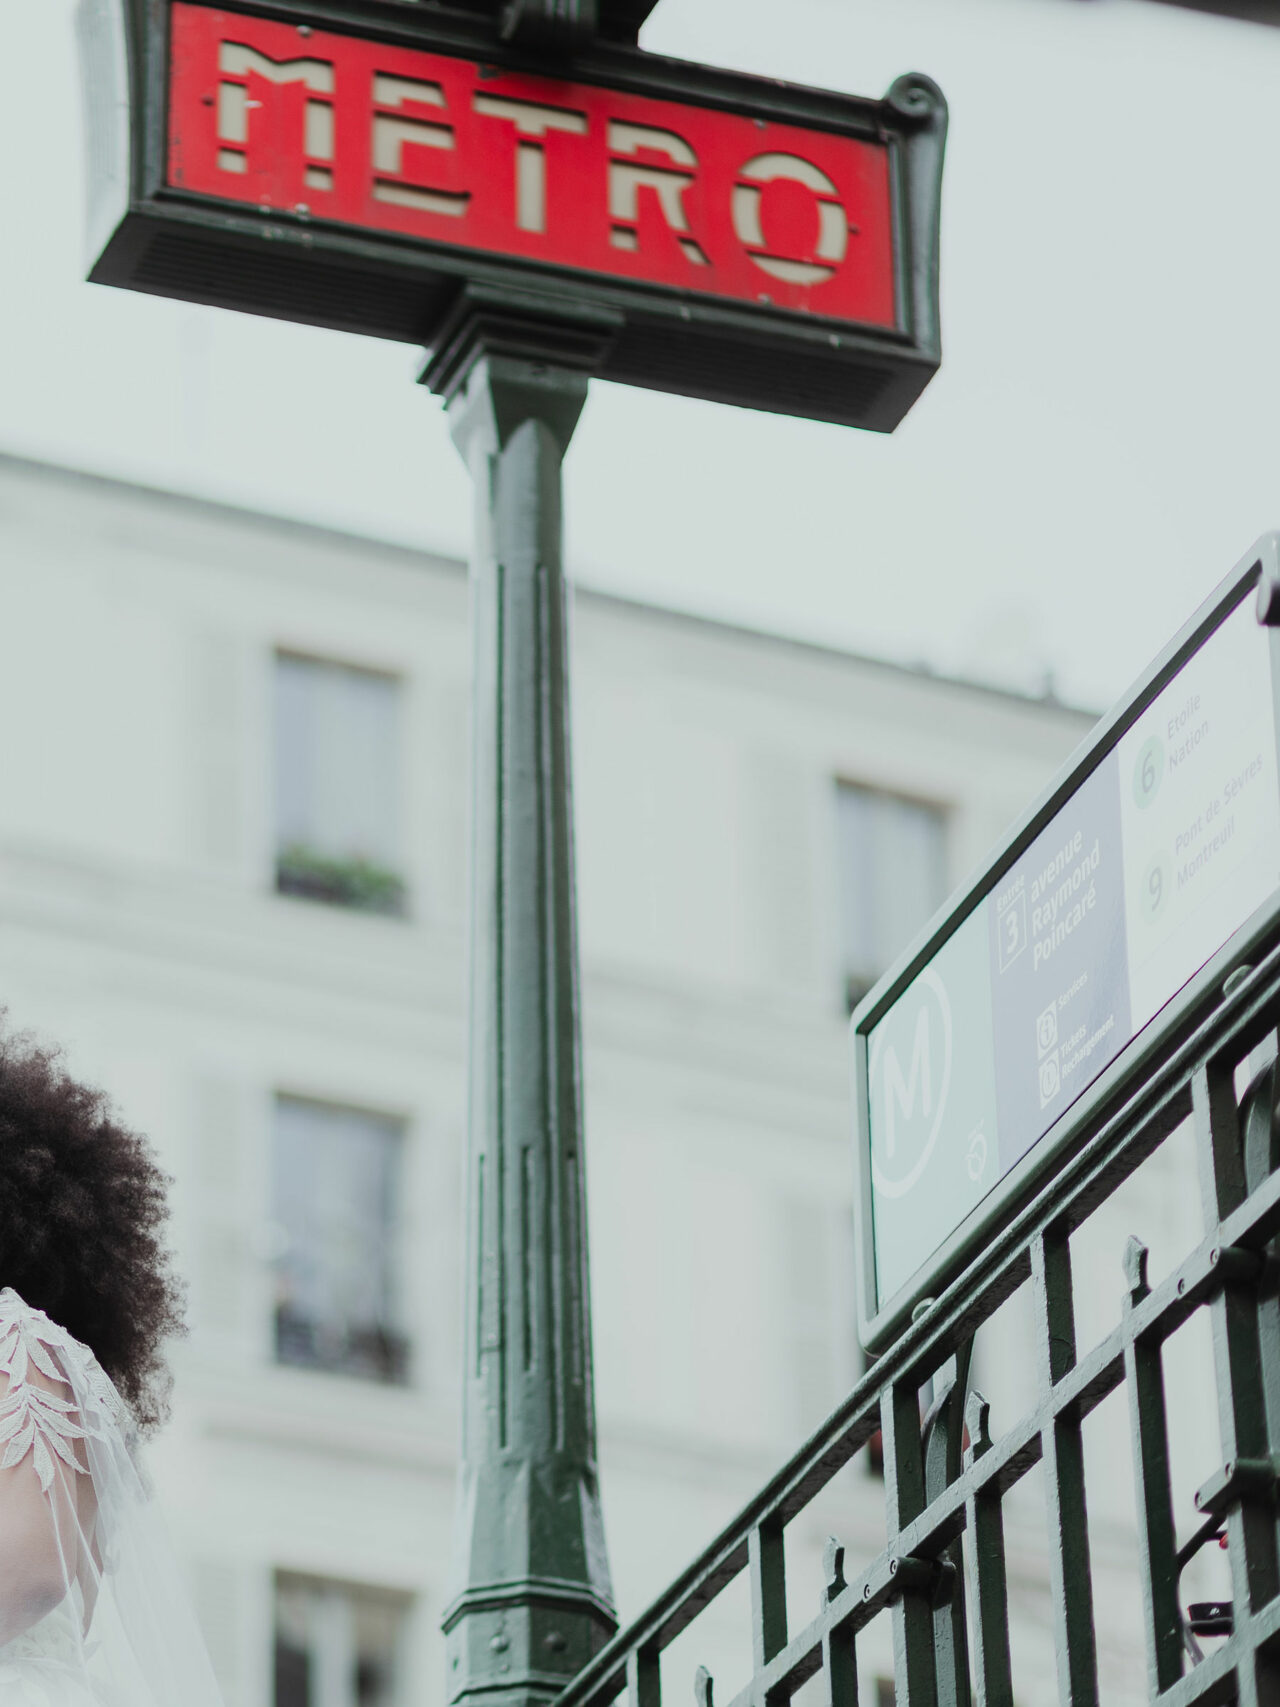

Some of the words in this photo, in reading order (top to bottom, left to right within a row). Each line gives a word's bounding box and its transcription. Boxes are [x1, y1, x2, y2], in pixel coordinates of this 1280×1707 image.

[217, 39, 848, 285] METRO
[1167, 695, 1201, 741] Etoile
[1169, 720, 1209, 773] Nation
[1141, 749, 1156, 794] 6
[1175, 815, 1202, 857] Pont
[1205, 798, 1220, 825] de
[1176, 814, 1236, 891] Montreuil
[1031, 830, 1083, 904] avenue
[1032, 838, 1100, 937] Raymond
[1149, 866, 1164, 912] 9
[1005, 910, 1019, 955] 3
[1033, 878, 1097, 972] Poincaré
